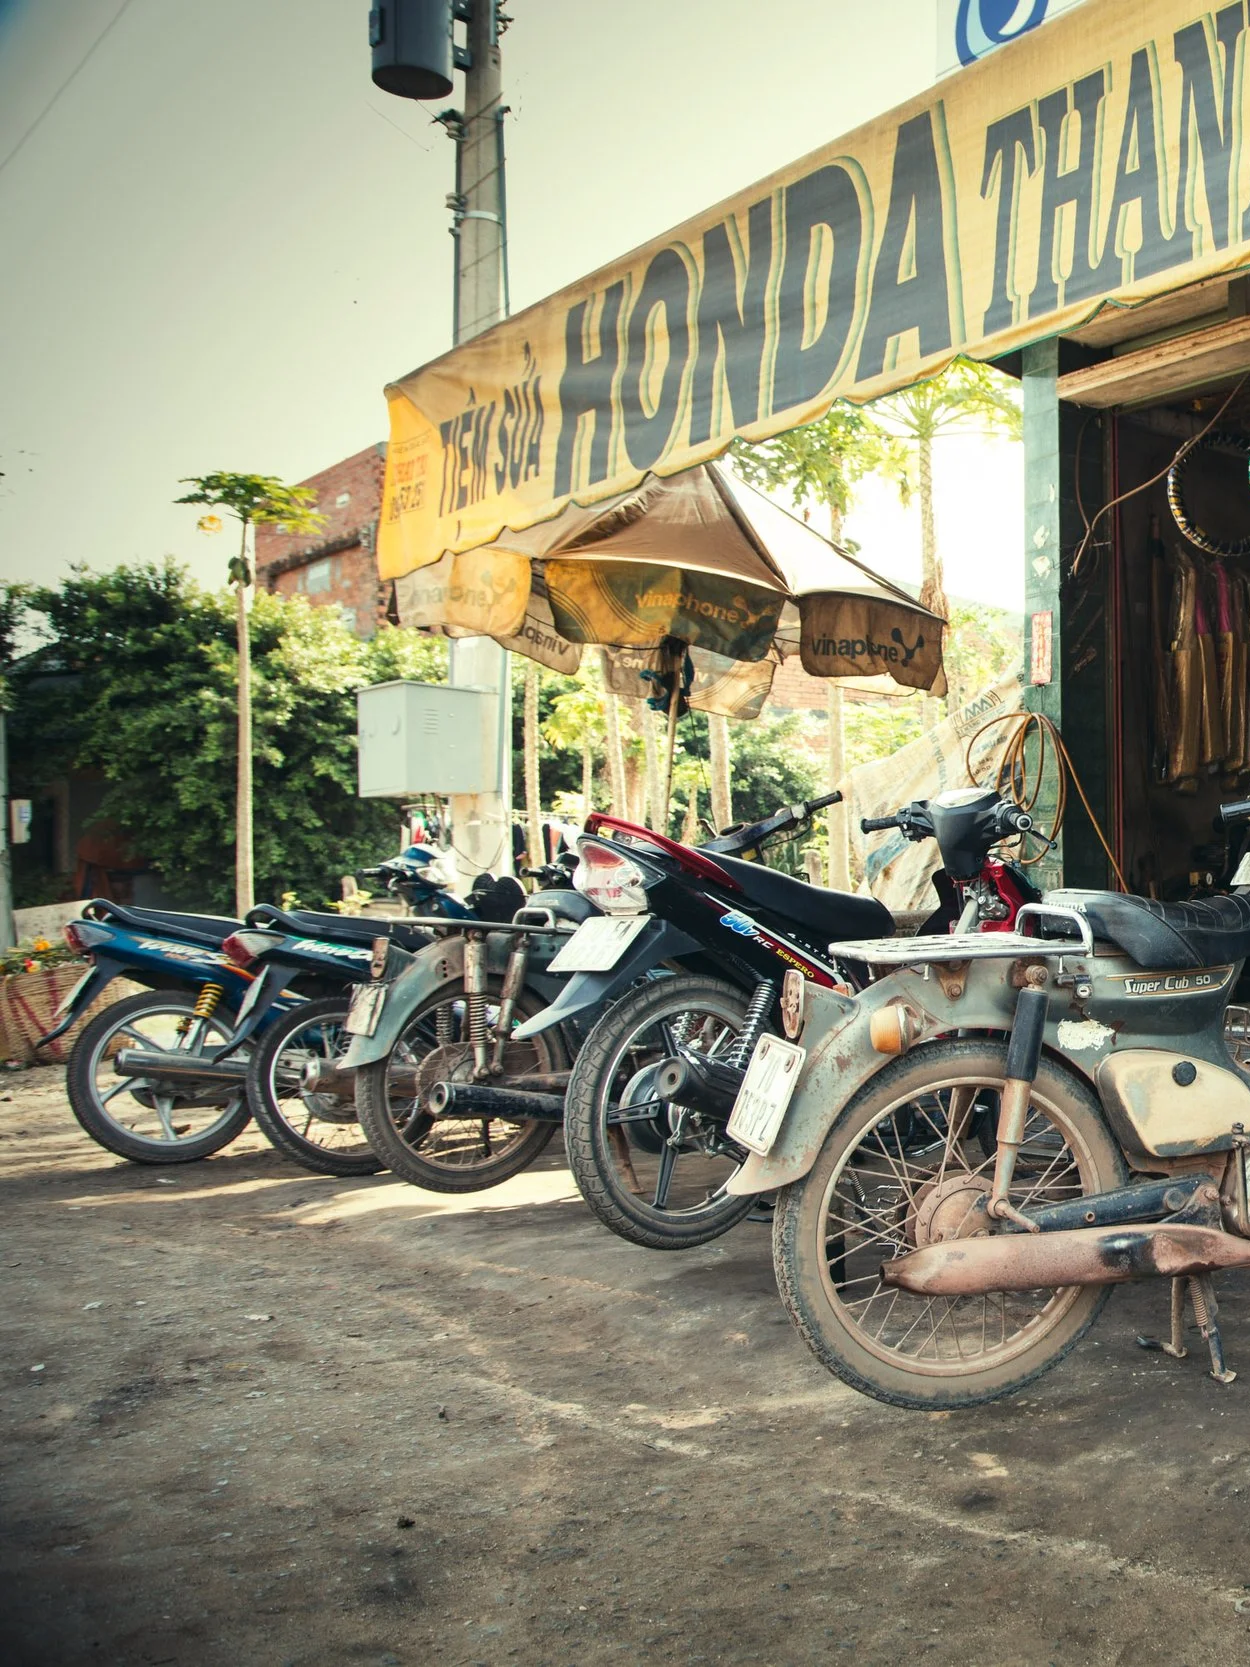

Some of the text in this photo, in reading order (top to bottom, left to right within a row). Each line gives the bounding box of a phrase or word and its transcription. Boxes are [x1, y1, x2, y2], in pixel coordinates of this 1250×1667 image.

[555, 98, 965, 498] HONDA
[635, 590, 739, 624] vinaphone
[775, 948, 815, 979] ESPERO
[1124, 974, 1211, 995] Super Cub 50
